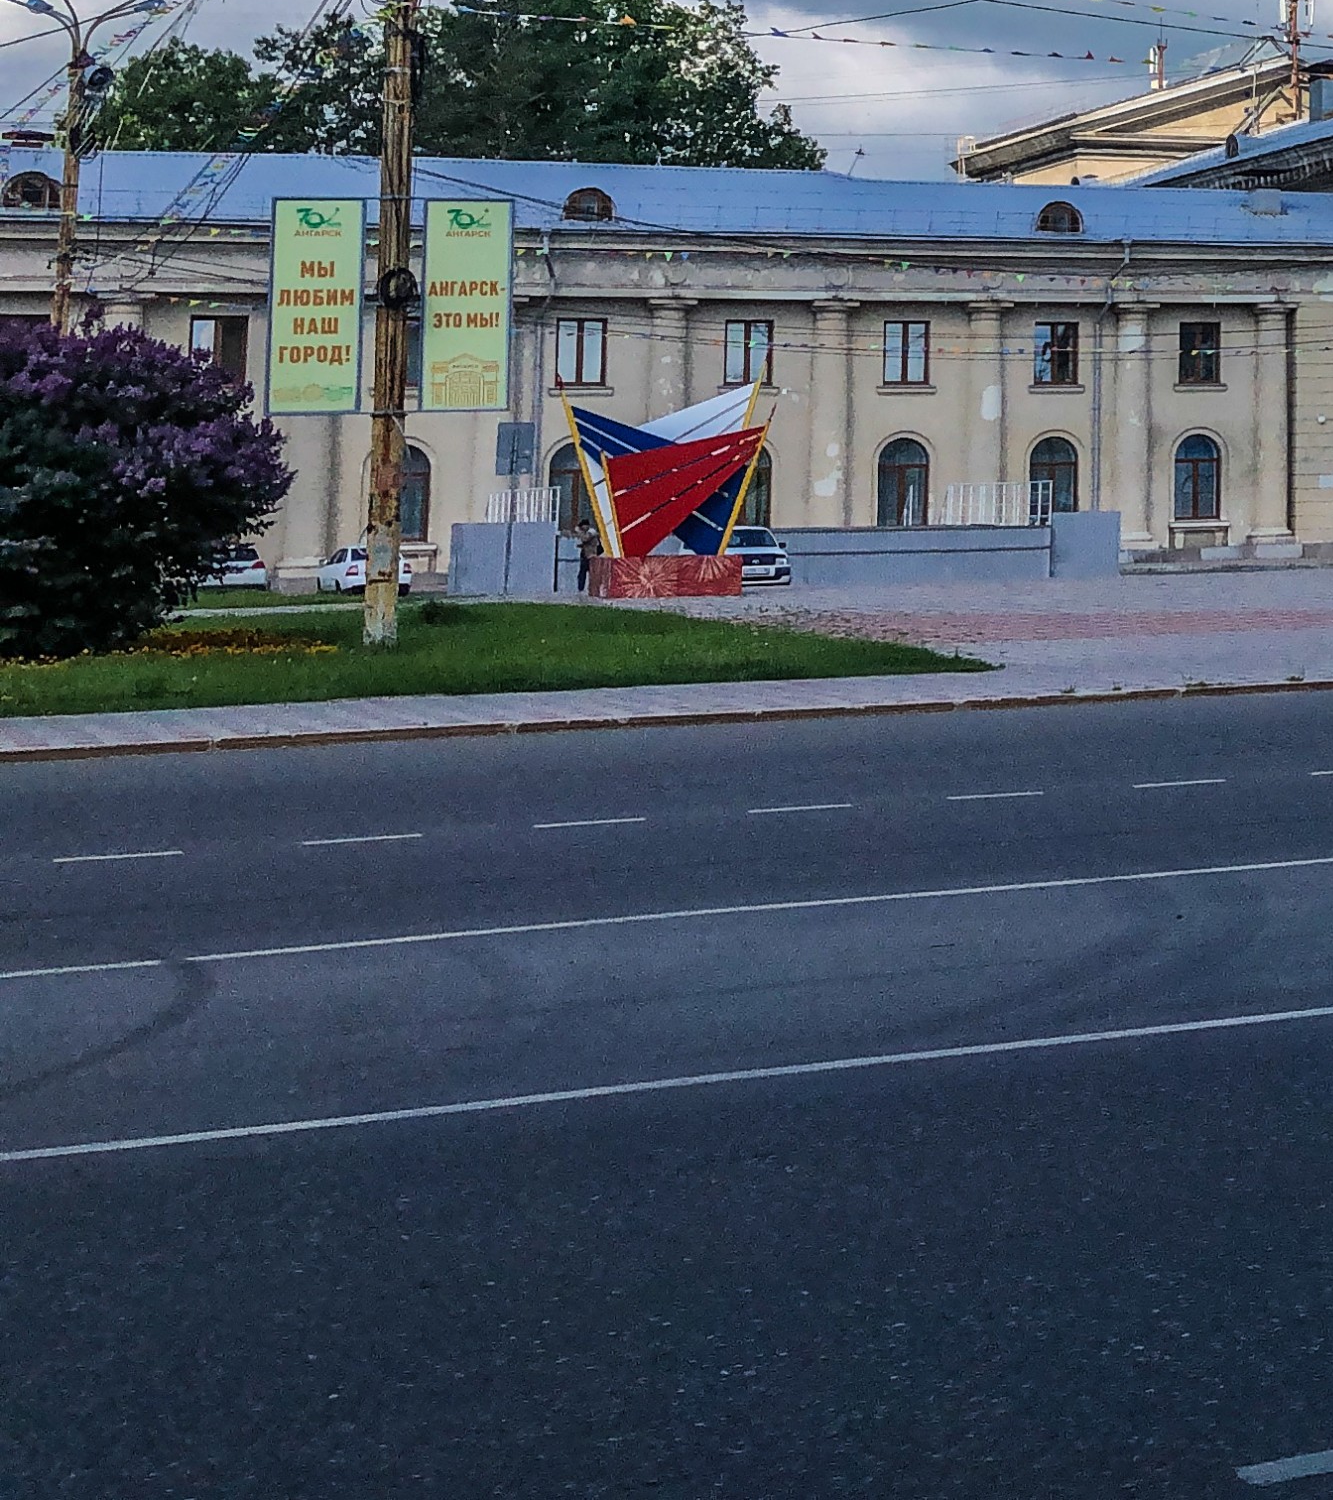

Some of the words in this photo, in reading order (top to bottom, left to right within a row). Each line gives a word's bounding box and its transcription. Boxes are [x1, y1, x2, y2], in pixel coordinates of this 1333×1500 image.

[294, 229, 341, 237] АНГАРСК
[300, 260, 335, 278] МЫ
[277, 288, 355, 307] ЛЮБИМ
[428, 280, 506, 297] АНГАРСК-
[293, 317, 339, 335] НАШ
[432, 313, 461, 329] ЭТО
[467, 312, 500, 328] МЫ!
[278, 345, 351, 366] ГОРОД!
